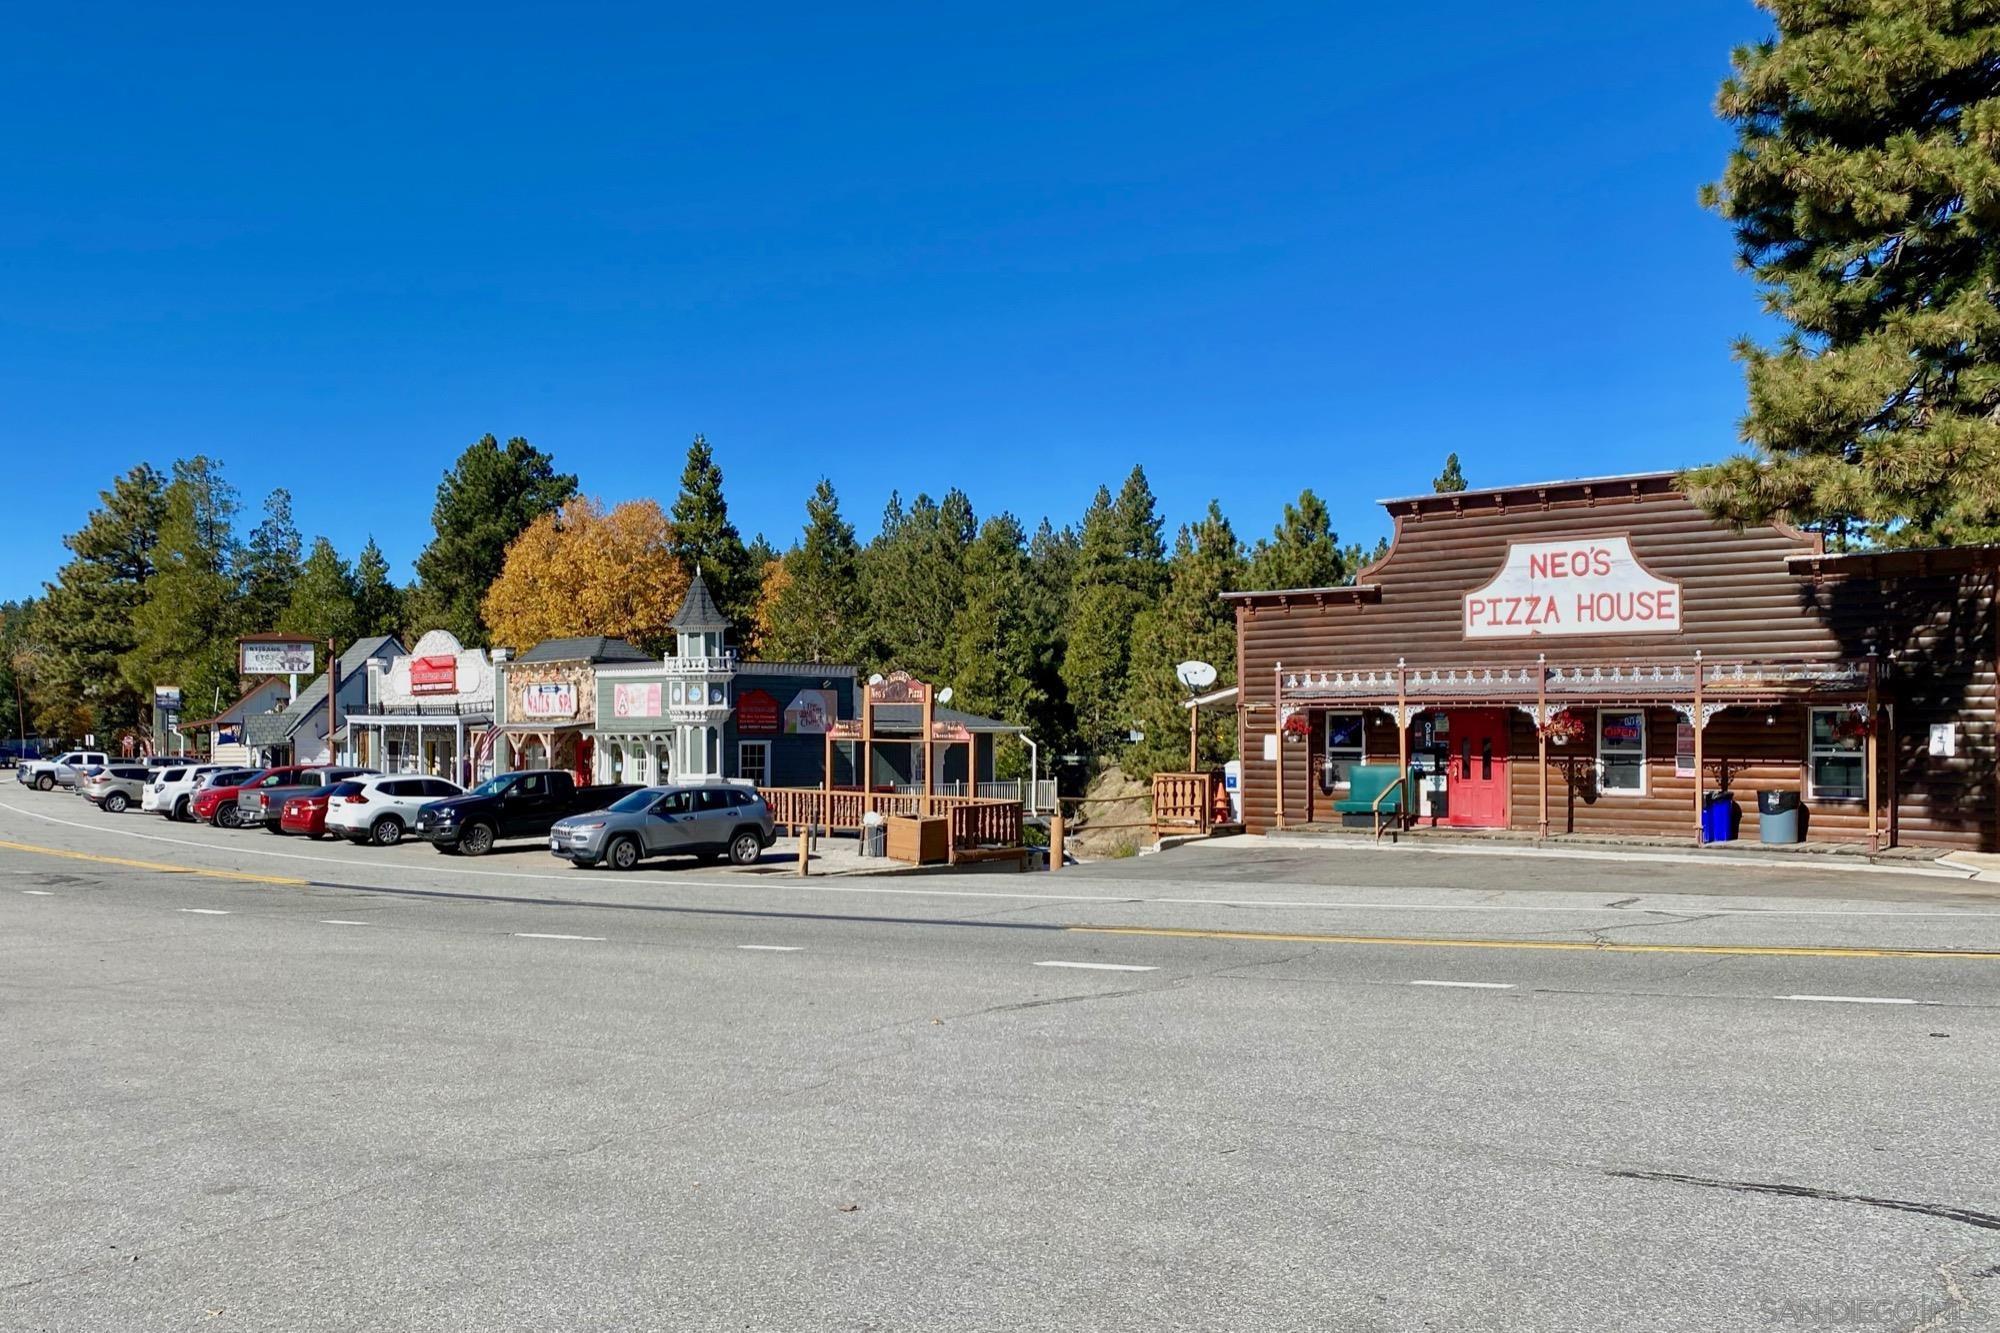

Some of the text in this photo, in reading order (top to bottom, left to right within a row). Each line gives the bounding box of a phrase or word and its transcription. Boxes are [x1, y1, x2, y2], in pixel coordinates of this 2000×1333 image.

[1530, 547, 1612, 579] NEO'S
[1469, 590, 1675, 626] PIZZA HOUSE
[527, 694, 550, 713] NAILS
[559, 694, 573, 713] SPA
[908, 687, 923, 698] Pizza
[1424, 721, 1432, 748] OPEN
[1604, 727, 1637, 738] OPEN
